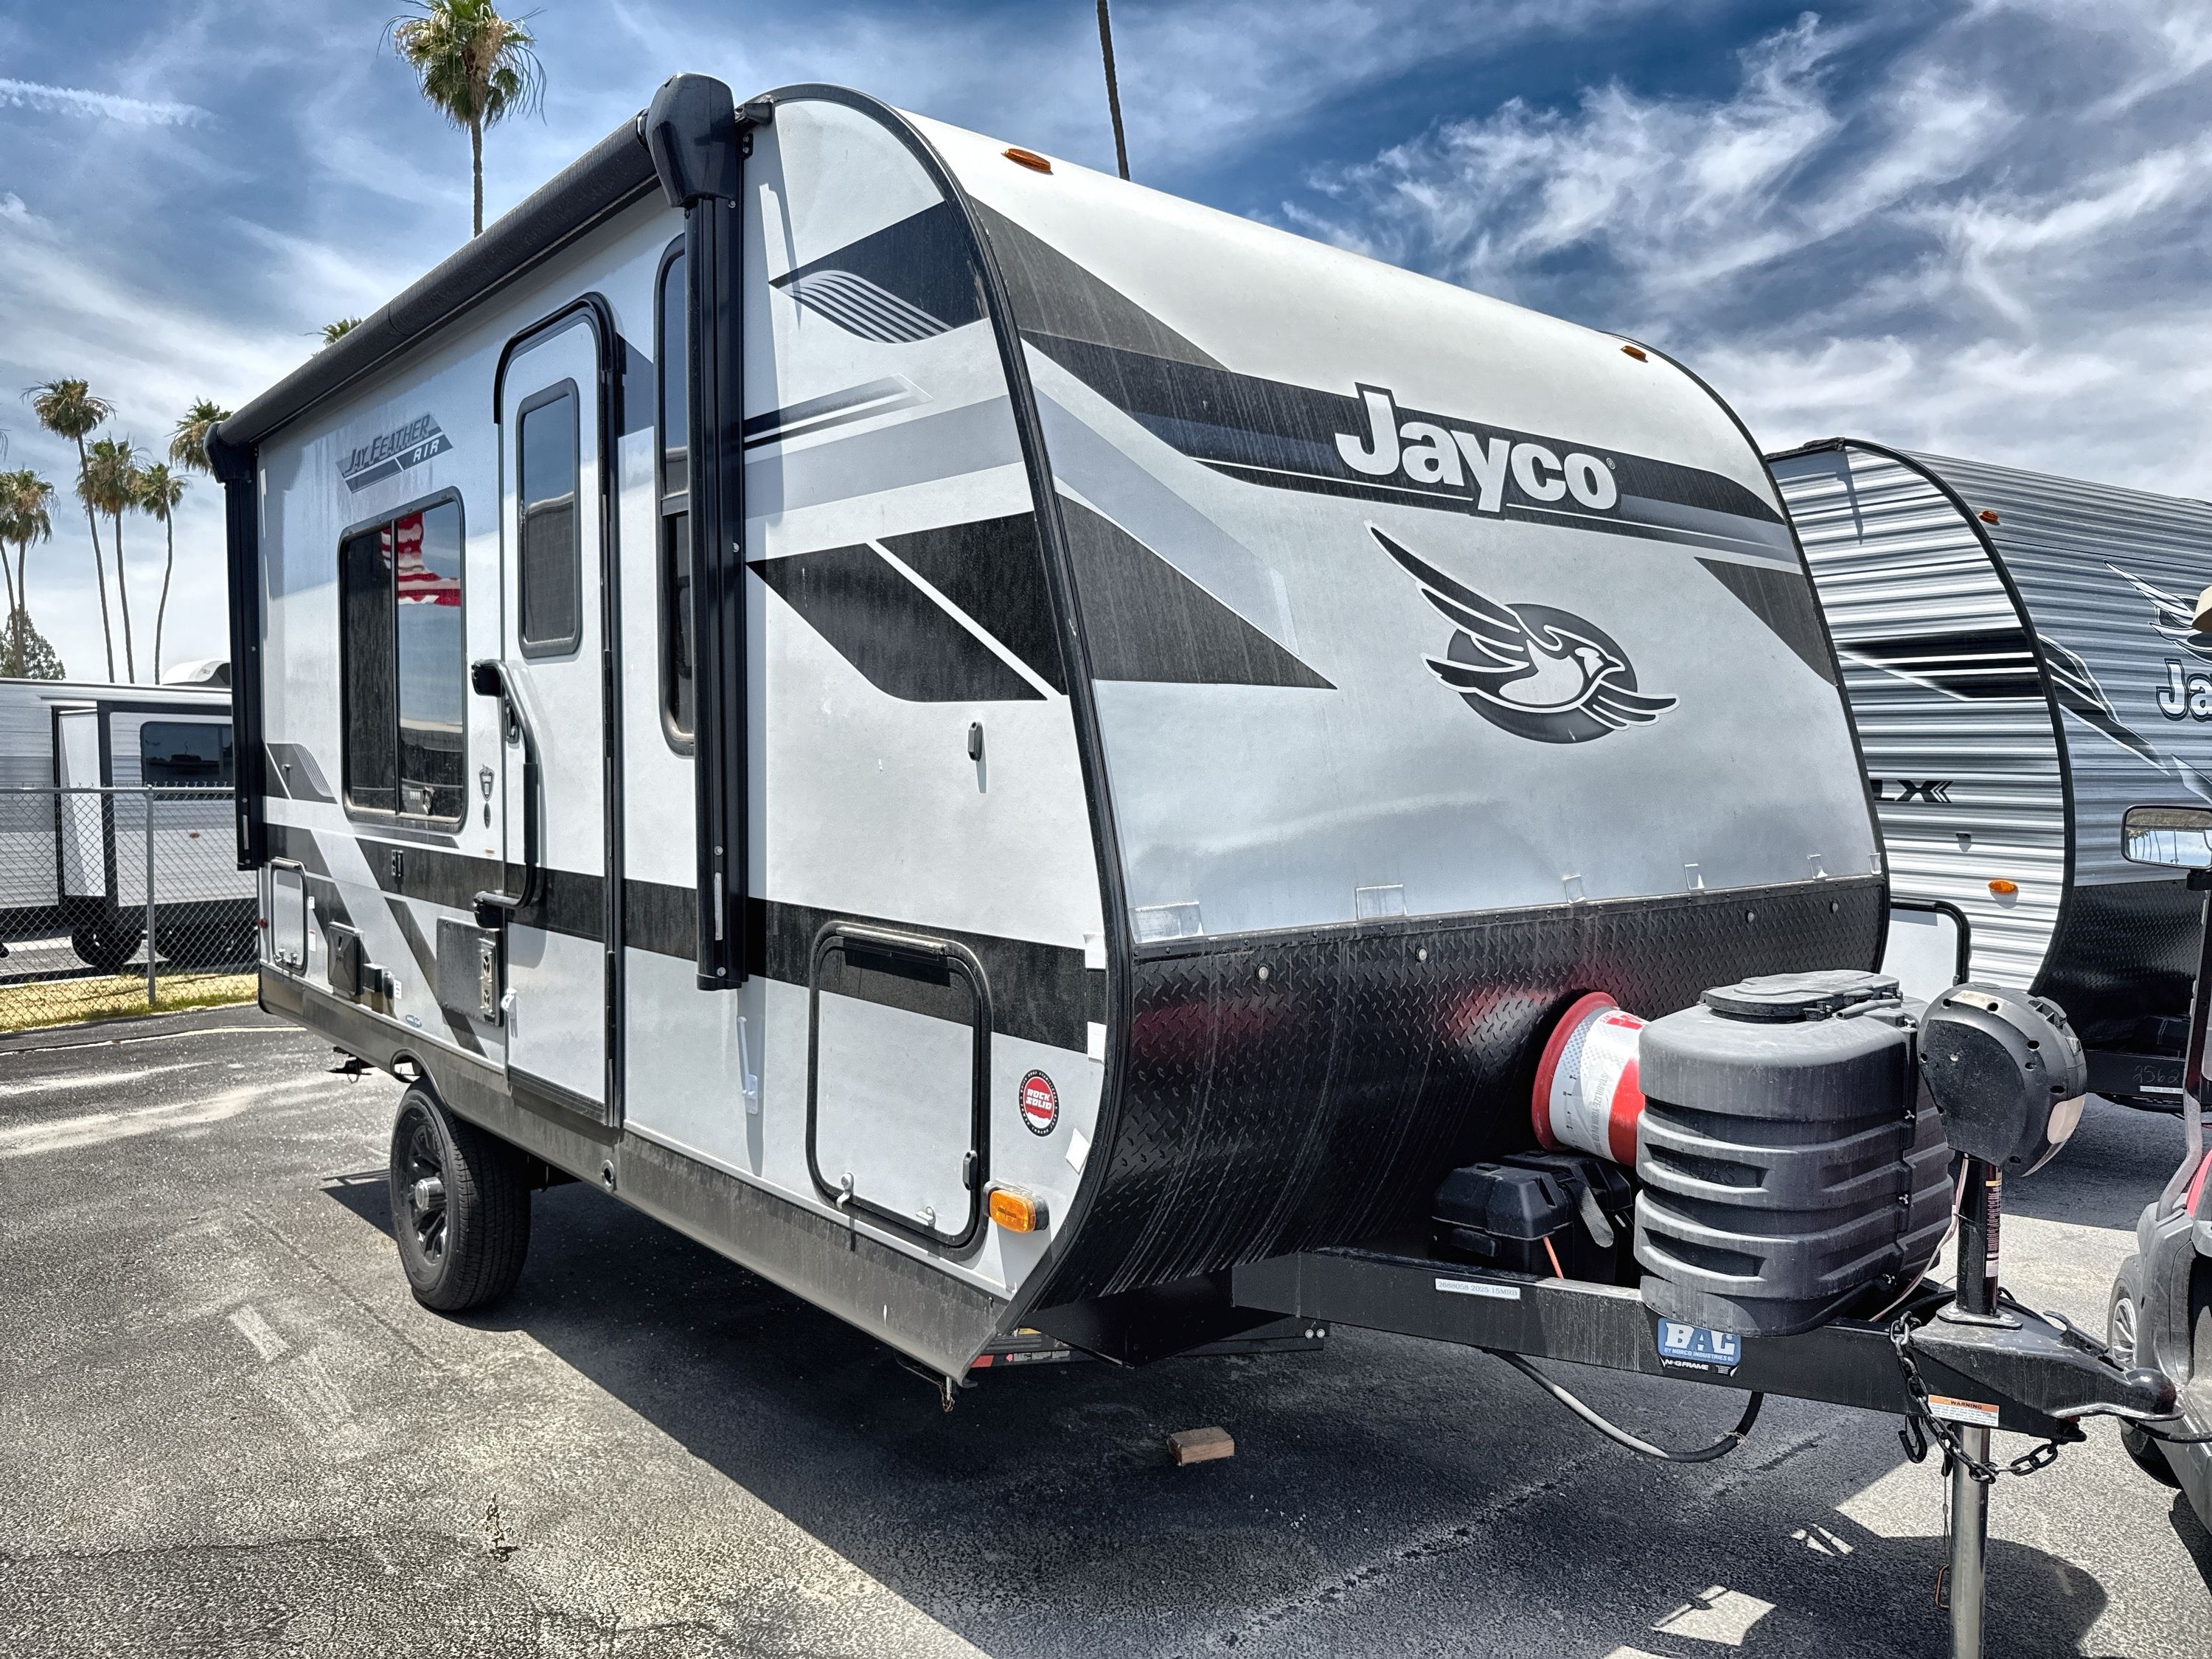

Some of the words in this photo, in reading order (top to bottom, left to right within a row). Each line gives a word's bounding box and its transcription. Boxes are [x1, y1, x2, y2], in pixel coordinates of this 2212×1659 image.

[369, 414, 431, 467] FEATHER
[412, 439, 440, 463] AIR
[1334, 389, 1617, 513] Jayco
[2155, 658, 2212, 723] Ja
[1026, 1088, 1051, 1101] ROCK
[1593, 1073, 1609, 1108] STABILIZE
[1025, 1096, 1052, 1110] SOLID
[1688, 1160, 1736, 1185] GAS
[1470, 1284, 1489, 1293] 2025
[1492, 1287, 1517, 1295] 15MRB
[1665, 1322, 1736, 1355] BAL
[1672, 1348, 1693, 1356] NORCO
[1693, 1351, 1728, 1361] INDUSTRIES
[1682, 1361, 1709, 1371] FRAME
[1950, 1400, 1983, 1410] WARNING
